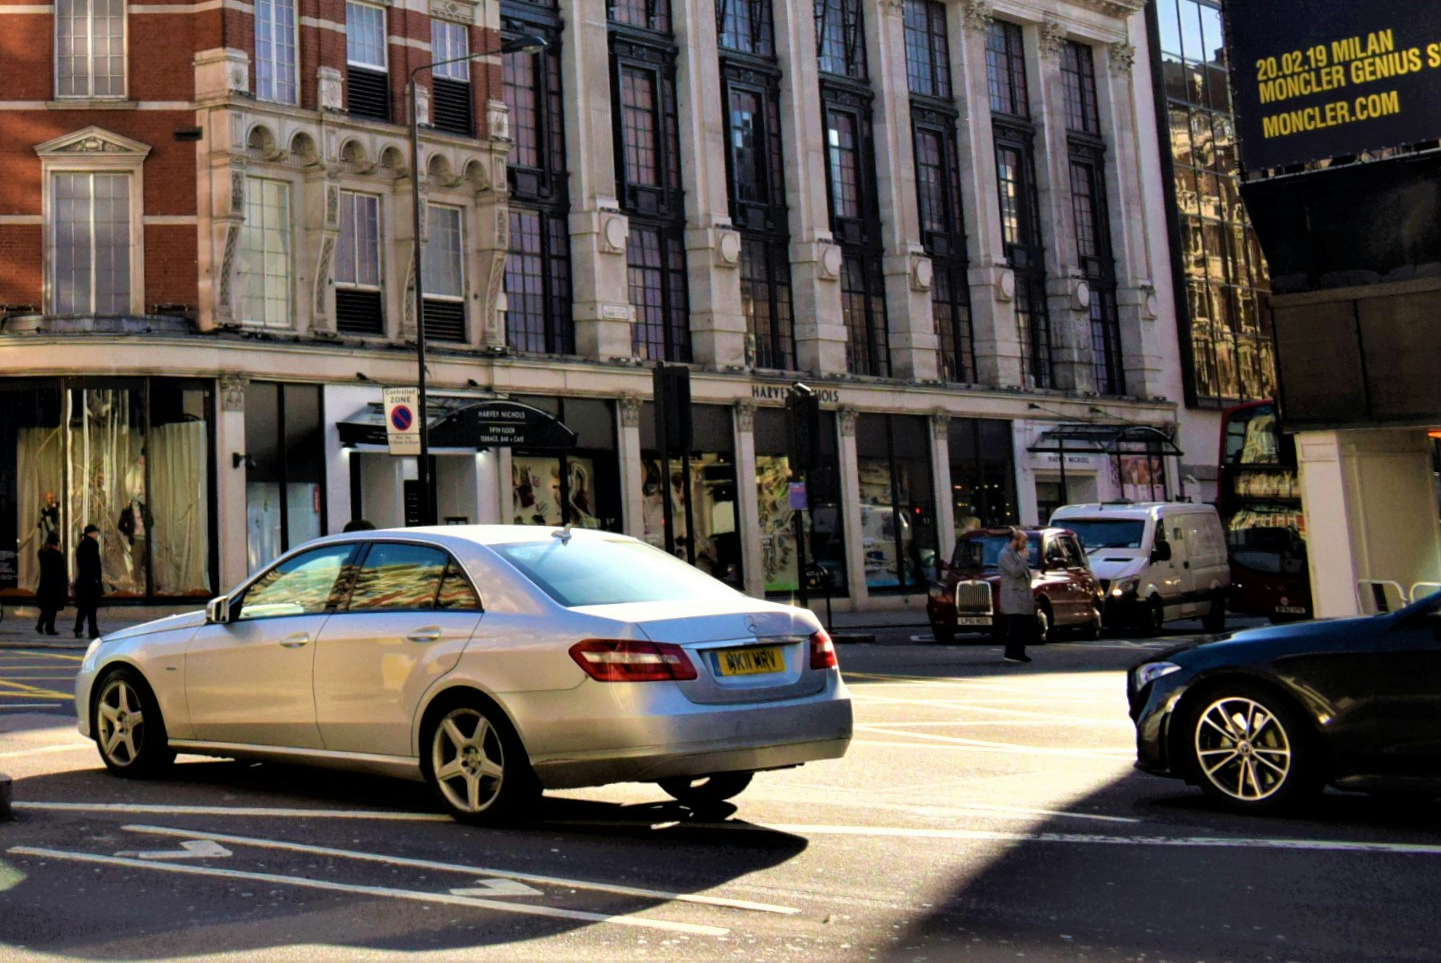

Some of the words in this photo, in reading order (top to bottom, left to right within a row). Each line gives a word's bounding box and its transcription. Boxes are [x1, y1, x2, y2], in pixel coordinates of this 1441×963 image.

[1255, 44, 1328, 82] 20.02.19
[1331, 28, 1394, 64] MILAN
[1259, 64, 1346, 104] MONCLER
[1350, 47, 1422, 85] GENIUS
[1426, 42, 1441, 68] S
[1262, 90, 1401, 139] MONCLER.COM
[478, 410, 499, 418] HARVEY
[501, 411, 526, 419] NICHOLS
